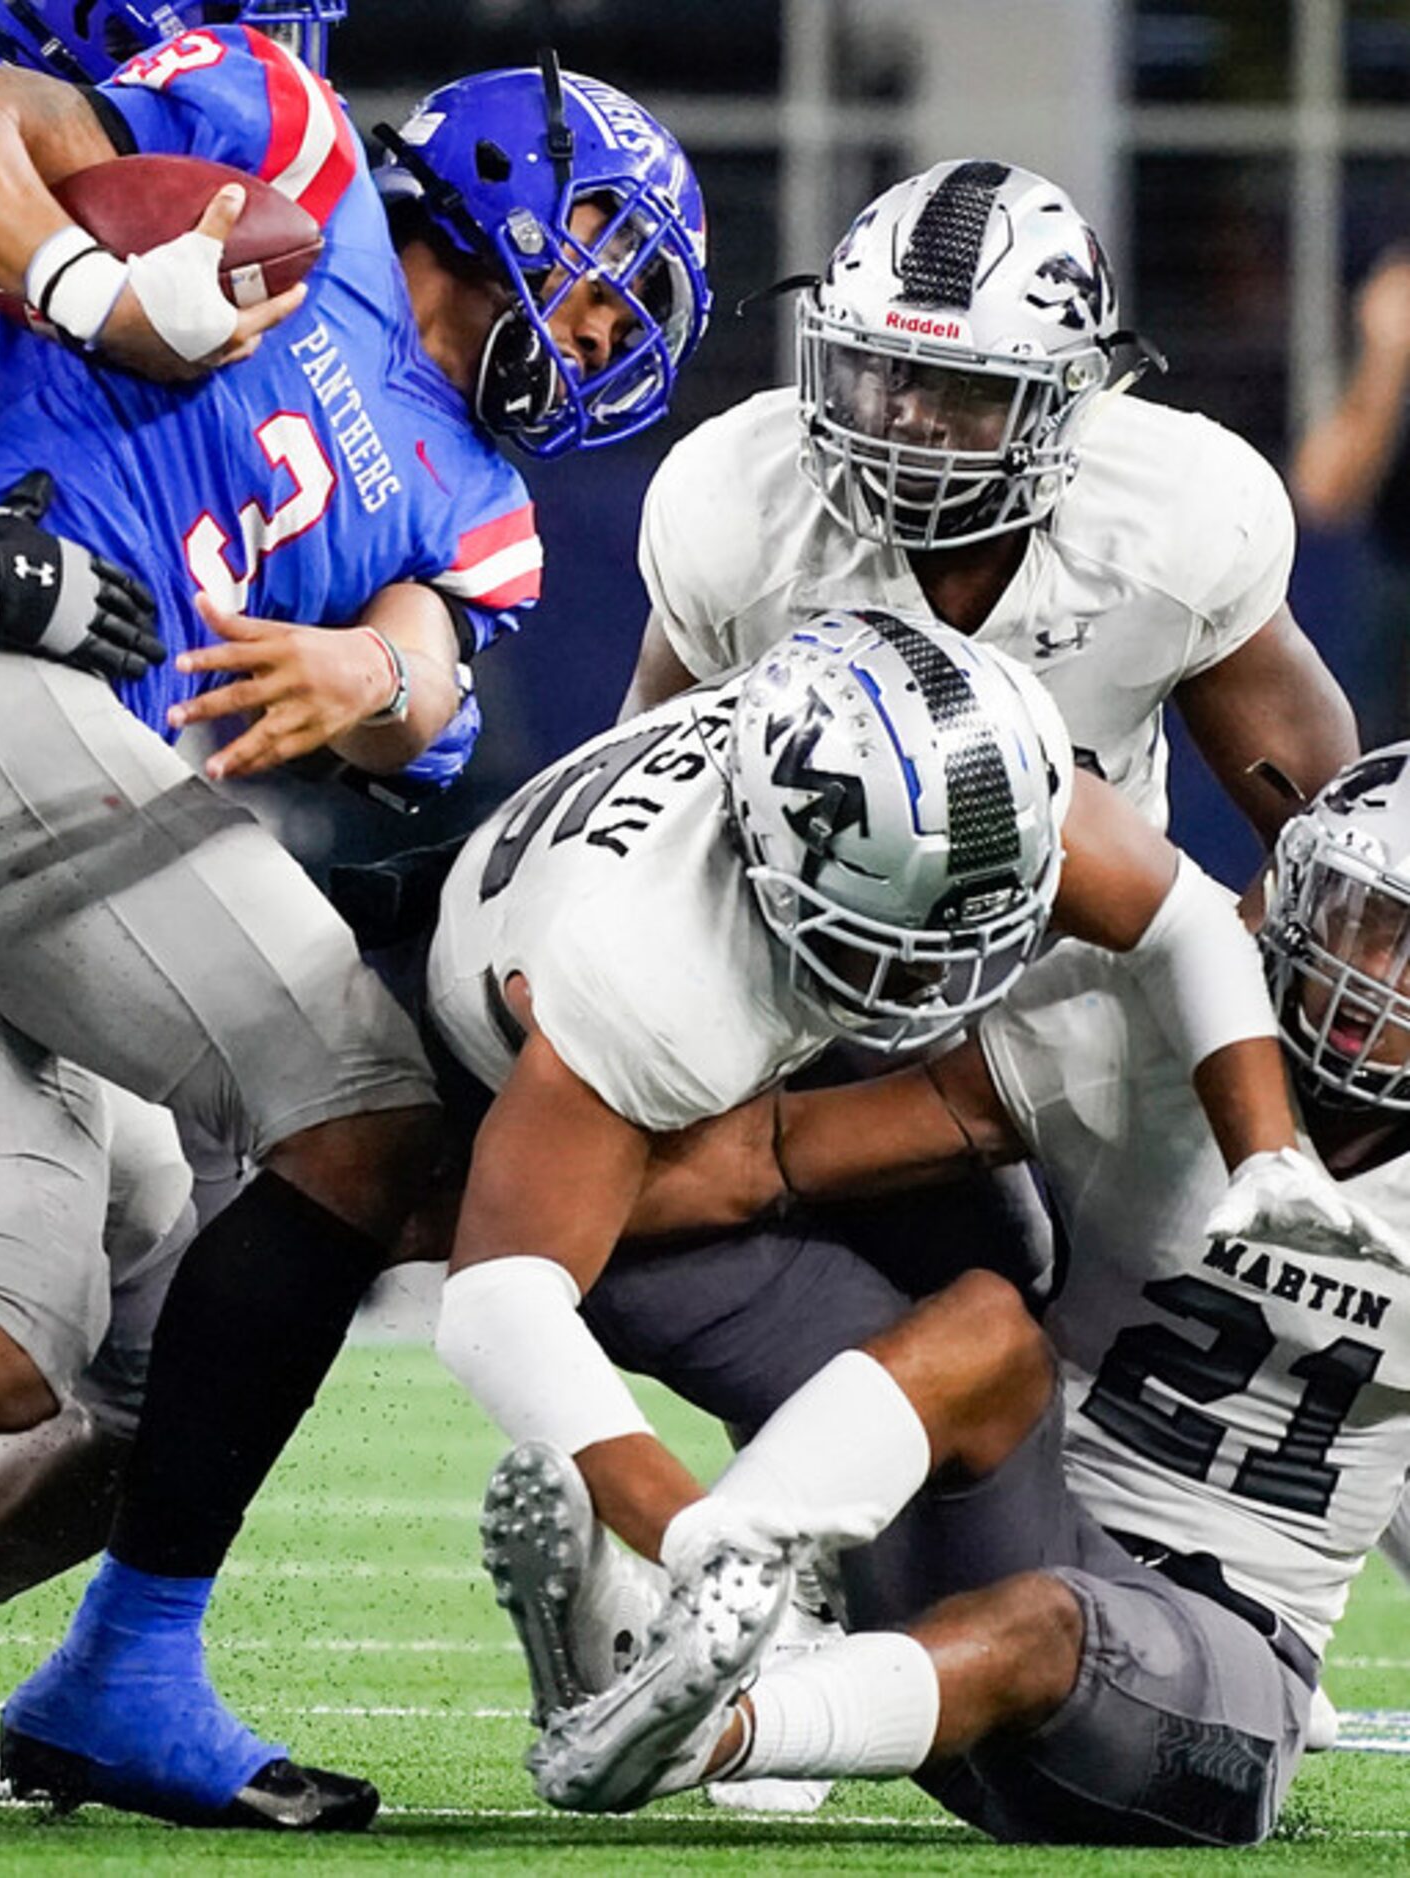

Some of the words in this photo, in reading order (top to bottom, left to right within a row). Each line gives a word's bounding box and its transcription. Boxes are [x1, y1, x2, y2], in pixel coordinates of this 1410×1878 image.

[112, 29, 228, 91] 3
[885, 311, 961, 340] Riddell
[290, 322, 403, 513] PANTHERS
[184, 409, 339, 616] 3
[1202, 1237, 1392, 1330] MARTIN
[1079, 1273, 1385, 1519] 21
